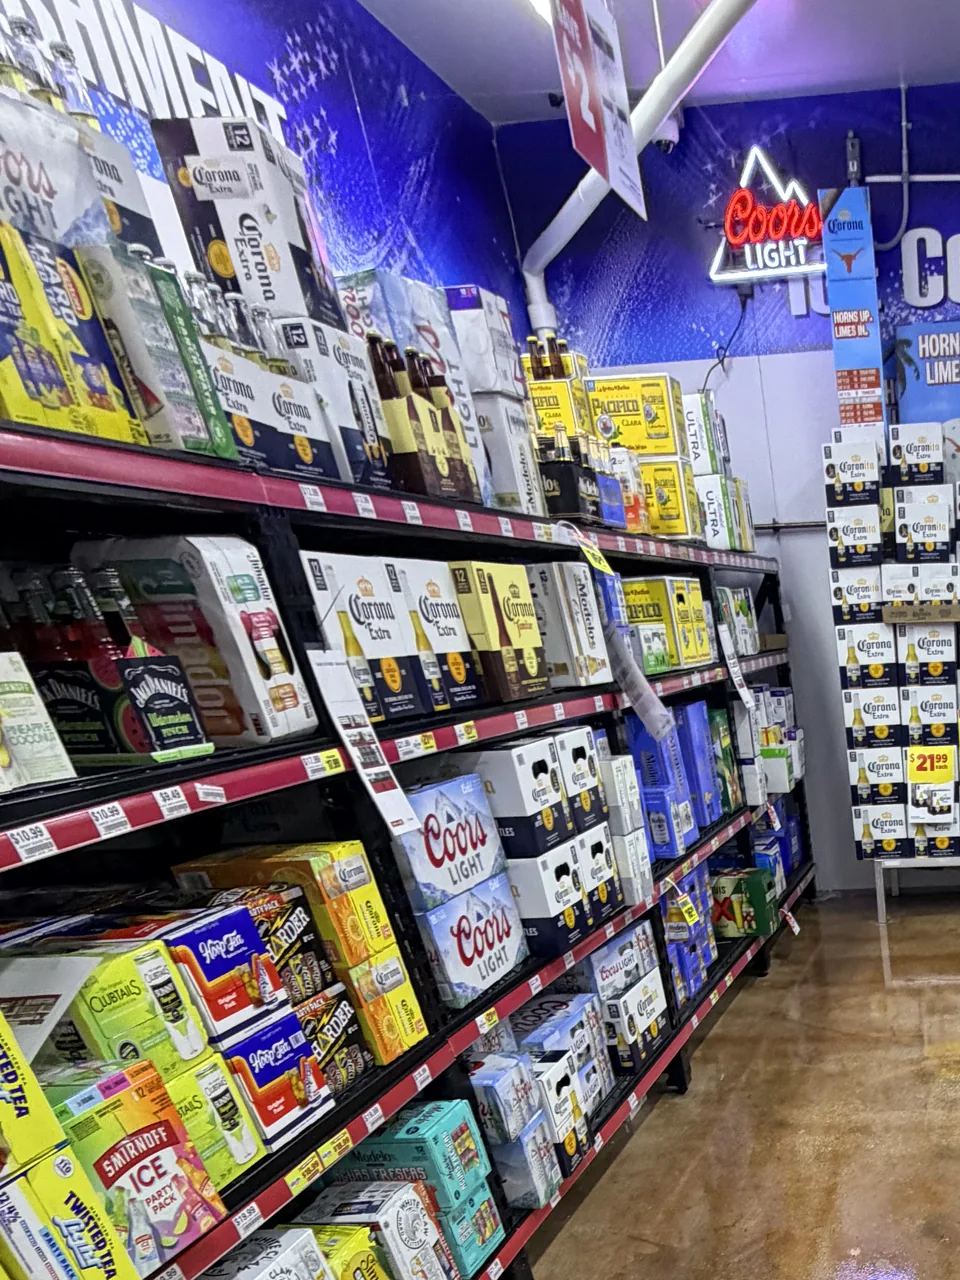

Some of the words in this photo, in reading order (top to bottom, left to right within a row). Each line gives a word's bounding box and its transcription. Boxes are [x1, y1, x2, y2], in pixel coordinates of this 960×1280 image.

[193, 166, 241, 186] Corona
[206, 181, 233, 194] Extra
[726, 188, 824, 246] Coors
[233, 237, 254, 282] Extra
[237, 212, 276, 302] Corona
[745, 239, 808, 269] LIGHT
[833, 311, 858, 323] HORNS
[859, 310, 873, 322] UP.
[834, 325, 857, 338] LIMES
[211, 364, 255, 402] Corona
[272, 391, 312, 422] Corona
[592, 397, 641, 416] PACIFICO
[621, 418, 642, 428] CLARA
[685, 410, 701, 462] ULTRA
[705, 489, 720, 539] ULTRA
[349, 594, 396, 627] Corona
[418, 595, 461, 624] Corona
[502, 596, 535, 623] Corona
[366, 623, 393, 642] Extra
[433, 621, 458, 638] Extra
[158, 790, 181, 803] $9.49
[91, 805, 121, 823] $10.99
[9, 825, 46, 846] $10.99
[423, 813, 488, 869] Coors
[447, 852, 486, 887] LIGHT
[450, 909, 512, 968] Coors
[477, 945, 510, 982] LIGHT
[89, 978, 142, 1014] CLUBTAILS
[102, 1124, 168, 1178] SMIRNOFF
[353, 1151, 392, 1163] Modelo
[129, 1154, 168, 1194] ICE
[144, 1182, 176, 1208] PARTY
[152, 1195, 178, 1215] PACK
[233, 1205, 257, 1227] $19.99
[41, 1228, 63, 1260] PARTY
[63, 1190, 108, 1252] TWISTED
[101, 1247, 118, 1280] TEA
